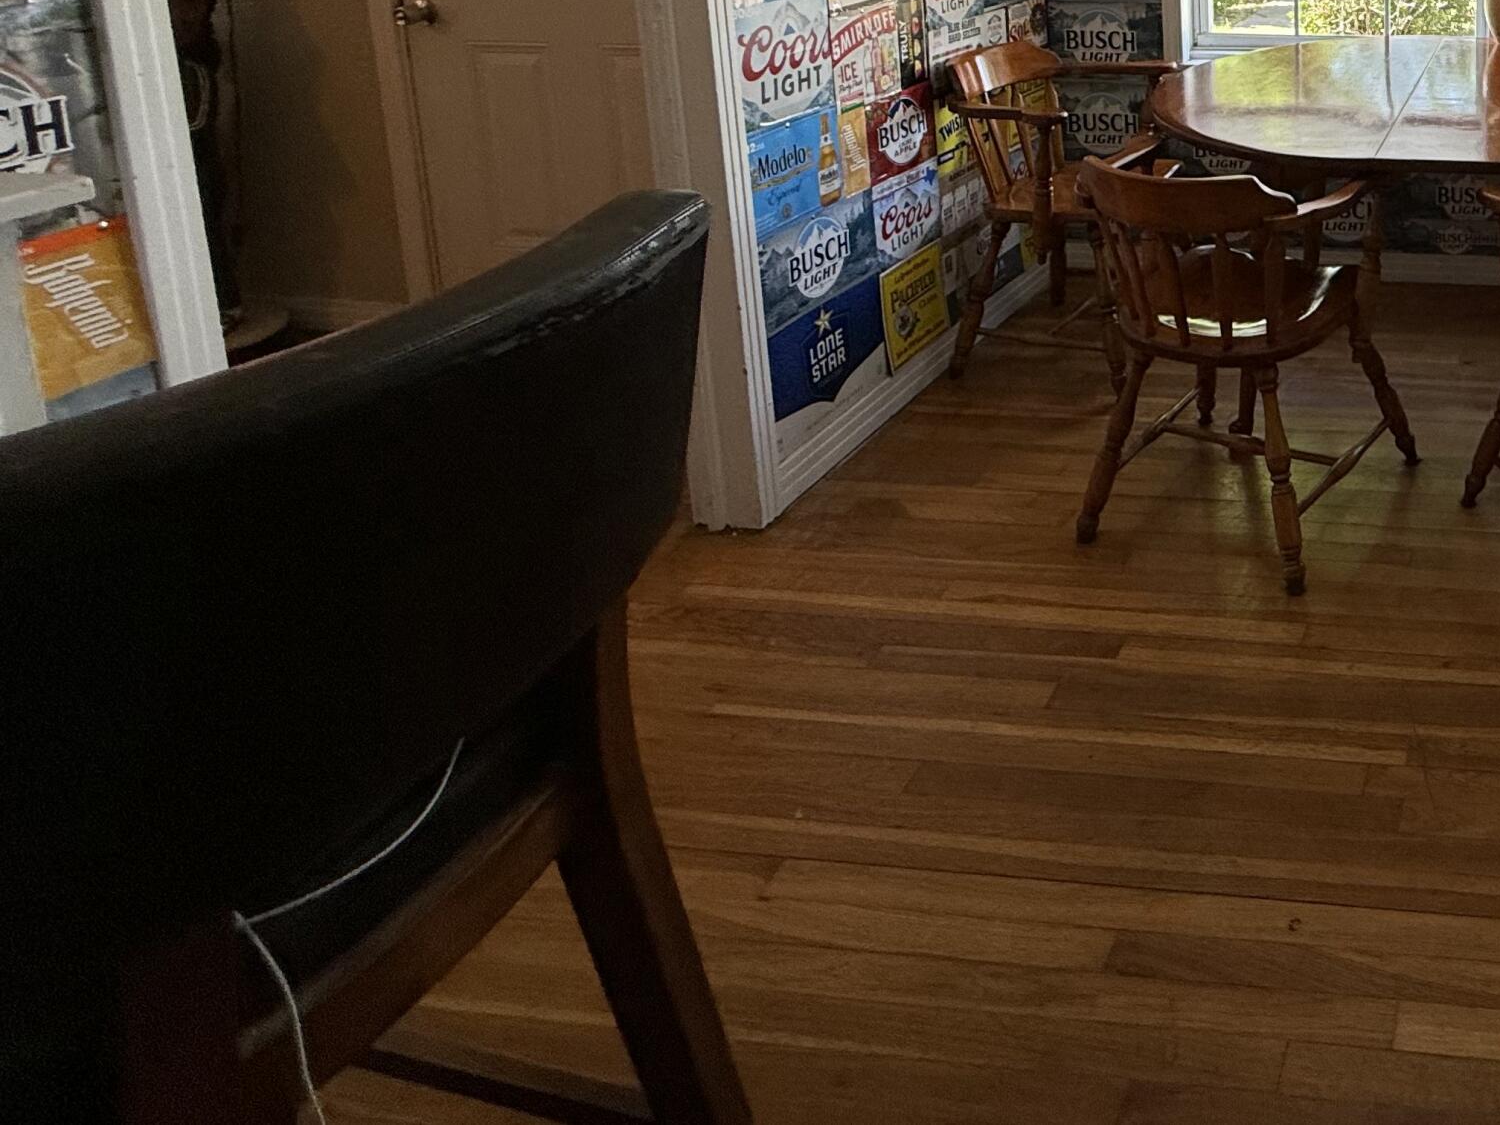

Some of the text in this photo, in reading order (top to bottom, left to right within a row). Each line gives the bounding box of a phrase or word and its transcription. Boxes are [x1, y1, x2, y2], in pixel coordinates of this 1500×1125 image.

[941, 0, 970, 13] LIGHT
[832, 8, 896, 61] SMIRNOFF
[738, 25, 833, 82] Coors
[840, 61, 858, 79] ICE
[761, 64, 825, 105] LIGHT
[879, 115, 927, 149] BUSCH
[1067, 113, 1138, 135] BUSCH
[1083, 134, 1124, 145] LIGHT
[758, 146, 806, 179] Modelo
[880, 202, 933, 241] Coors
[891, 224, 926, 252] LIGHT
[789, 231, 849, 283] BUSCH
[803, 261, 838, 292] LIGHT
[809, 328, 844, 365] LONE
[811, 346, 847, 383] STAR
